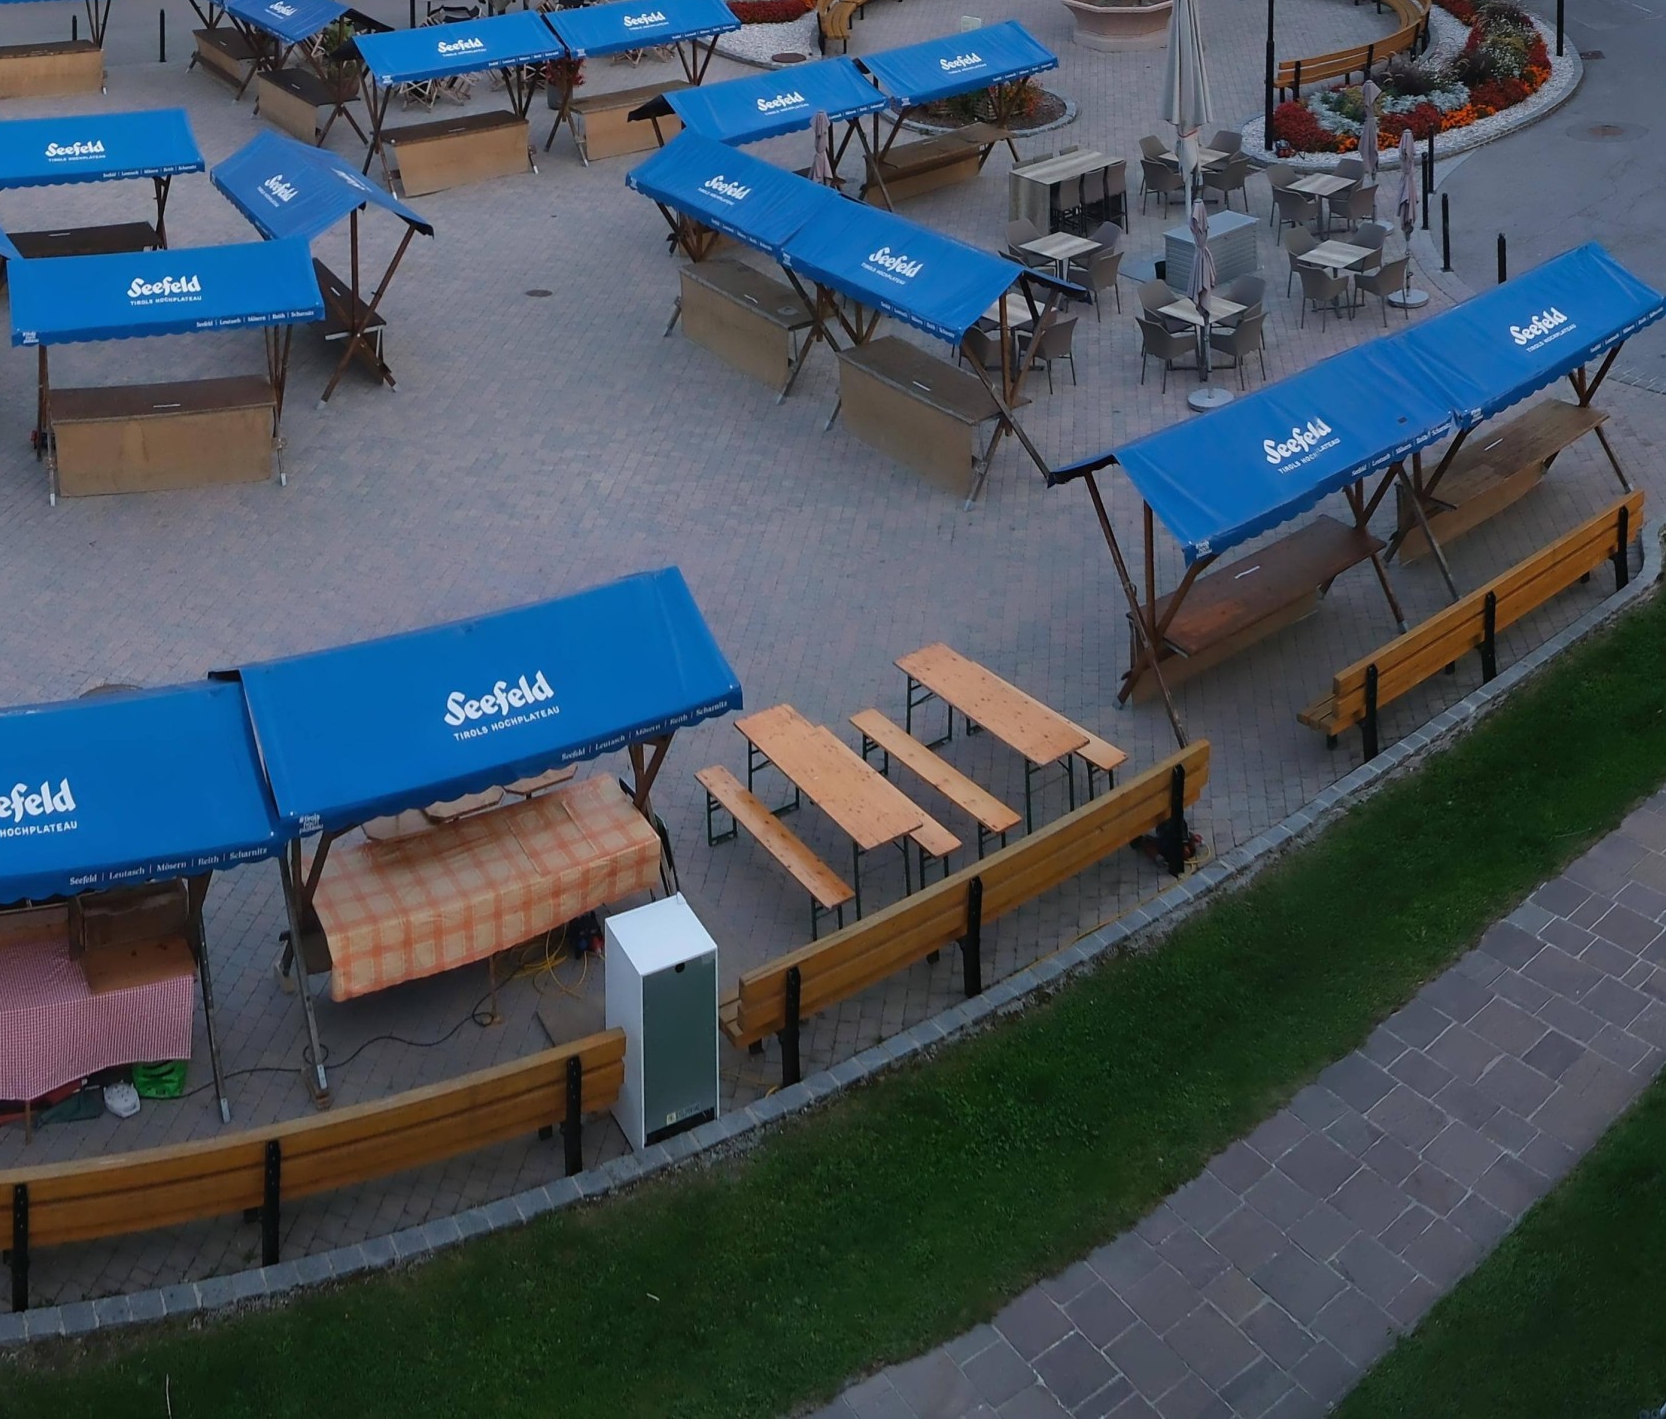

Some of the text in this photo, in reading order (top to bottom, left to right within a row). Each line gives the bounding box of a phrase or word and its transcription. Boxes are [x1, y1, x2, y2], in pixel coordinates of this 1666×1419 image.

[624, 11, 667, 27] Seefeld
[437, 37, 484, 53] Seefeld
[939, 52, 982, 71] Seefeld
[757, 91, 805, 111] Seefeld
[45, 140, 105, 158] Seefeld
[704, 175, 752, 200] Seefeld
[869, 247, 924, 278] Seefeld
[127, 274, 202, 298] Seefeld
[1509, 307, 1568, 345] Seefeld
[1263, 417, 1332, 464] Seefeld
[444, 670, 554, 727] Seefeld
[454, 706, 561, 742] TIROLS HOCHPLATEAU
[0, 821, 78, 837] HOCHPLATEAU
[69, 846, 268, 886] Seefeld Leutasch Mösern Reith Scharnitz
